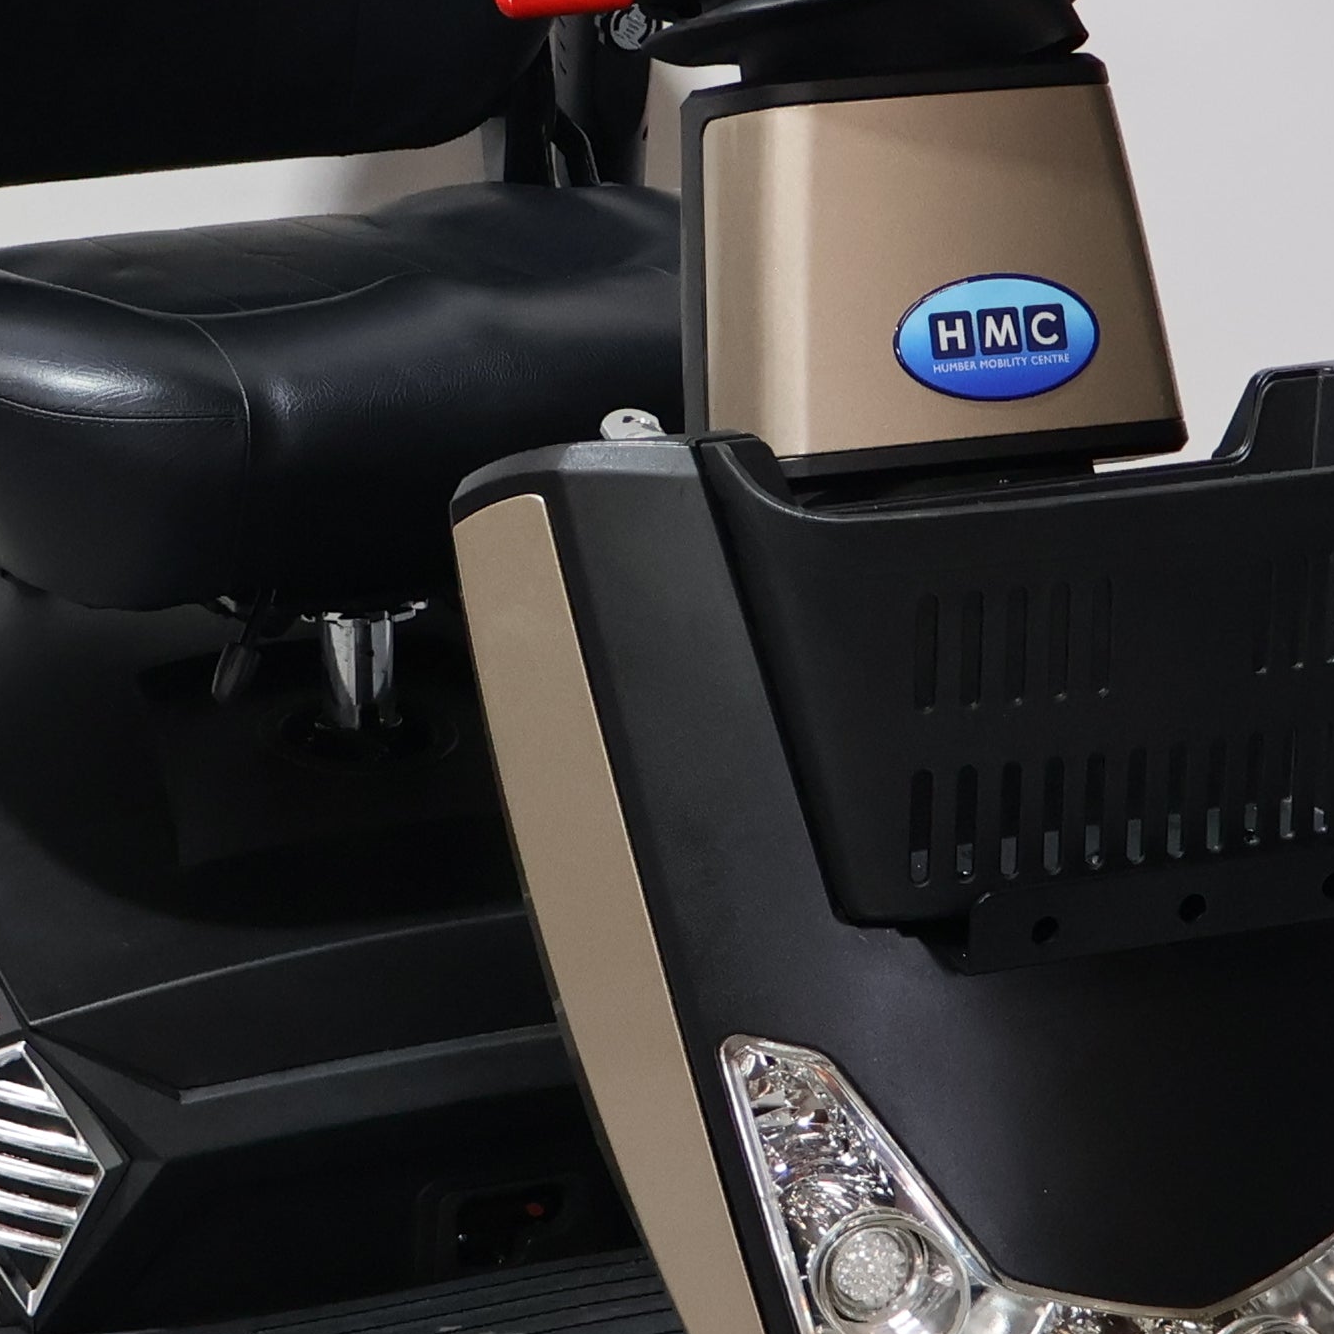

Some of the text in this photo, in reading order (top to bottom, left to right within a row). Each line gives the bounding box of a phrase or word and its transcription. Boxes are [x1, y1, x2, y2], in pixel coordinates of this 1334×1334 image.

[936, 311, 1060, 352] HMC
[933, 353, 1071, 374] HUMBER MOBILITY CENTRE
